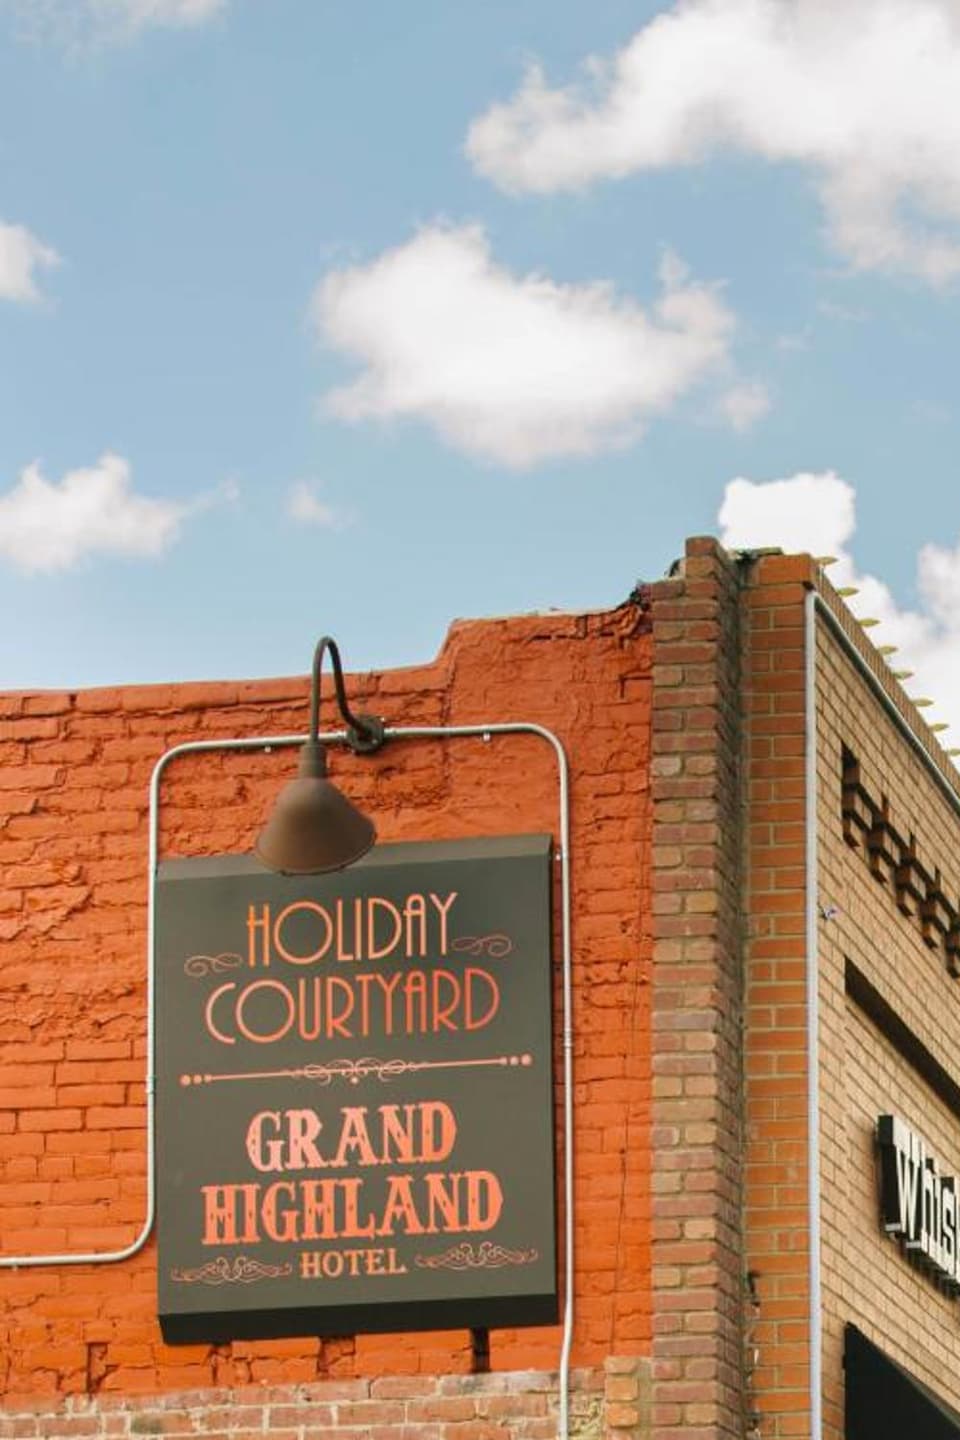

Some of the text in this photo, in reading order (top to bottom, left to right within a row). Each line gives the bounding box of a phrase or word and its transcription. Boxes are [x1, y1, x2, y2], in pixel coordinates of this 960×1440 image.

[247, 892, 458, 968] HOLIDAY
[204, 967, 501, 1044] COURTYARD
[245, 1100, 457, 1172] GRAND
[201, 1169, 504, 1246] HIGHLAND
[301, 1248, 407, 1279] HOTEL
